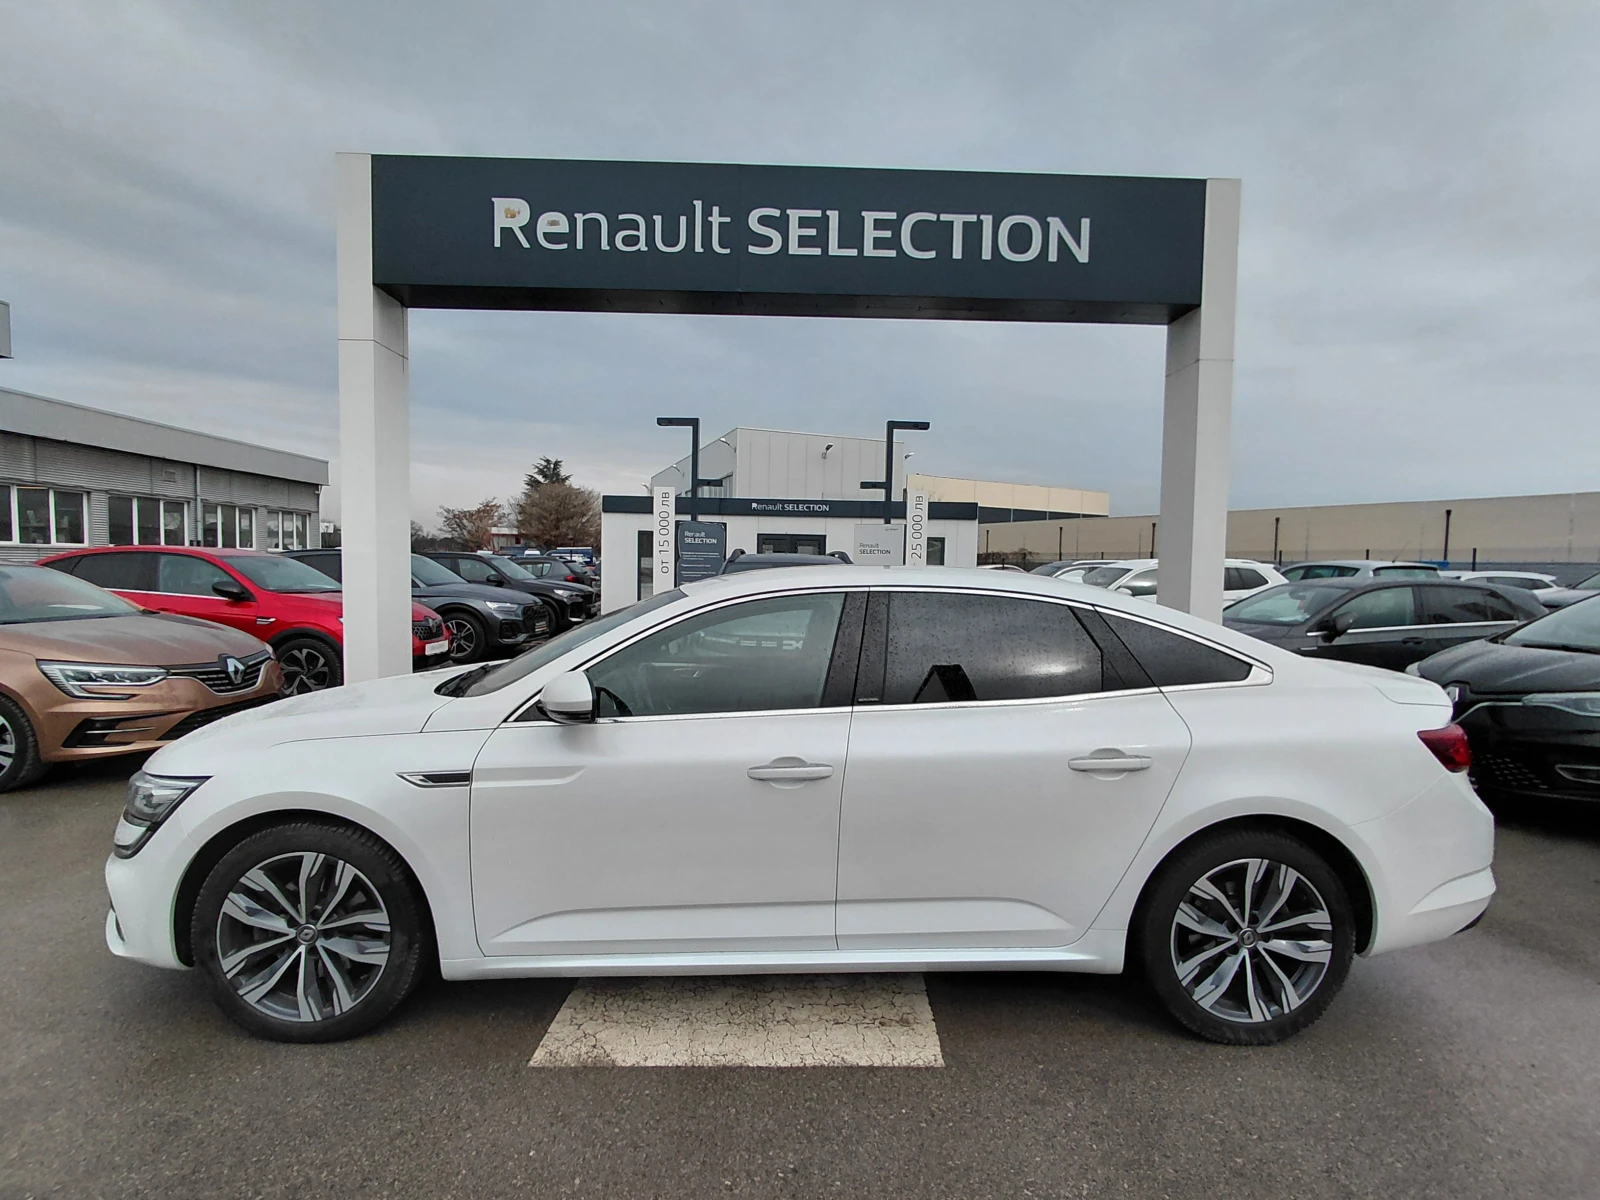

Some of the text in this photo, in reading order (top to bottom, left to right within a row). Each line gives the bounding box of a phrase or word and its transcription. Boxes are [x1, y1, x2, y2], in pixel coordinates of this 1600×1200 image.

[491, 196, 1092, 264] Renault SELECTION
[751, 502, 830, 512] Renault SELECTION
[658, 510, 670, 536] 000
[911, 514, 923, 540] 000
[684, 530, 706, 538] Renault
[684, 537, 718, 545] SELECTION
[658, 539, 670, 555] 15
[910, 543, 923, 560] 25
